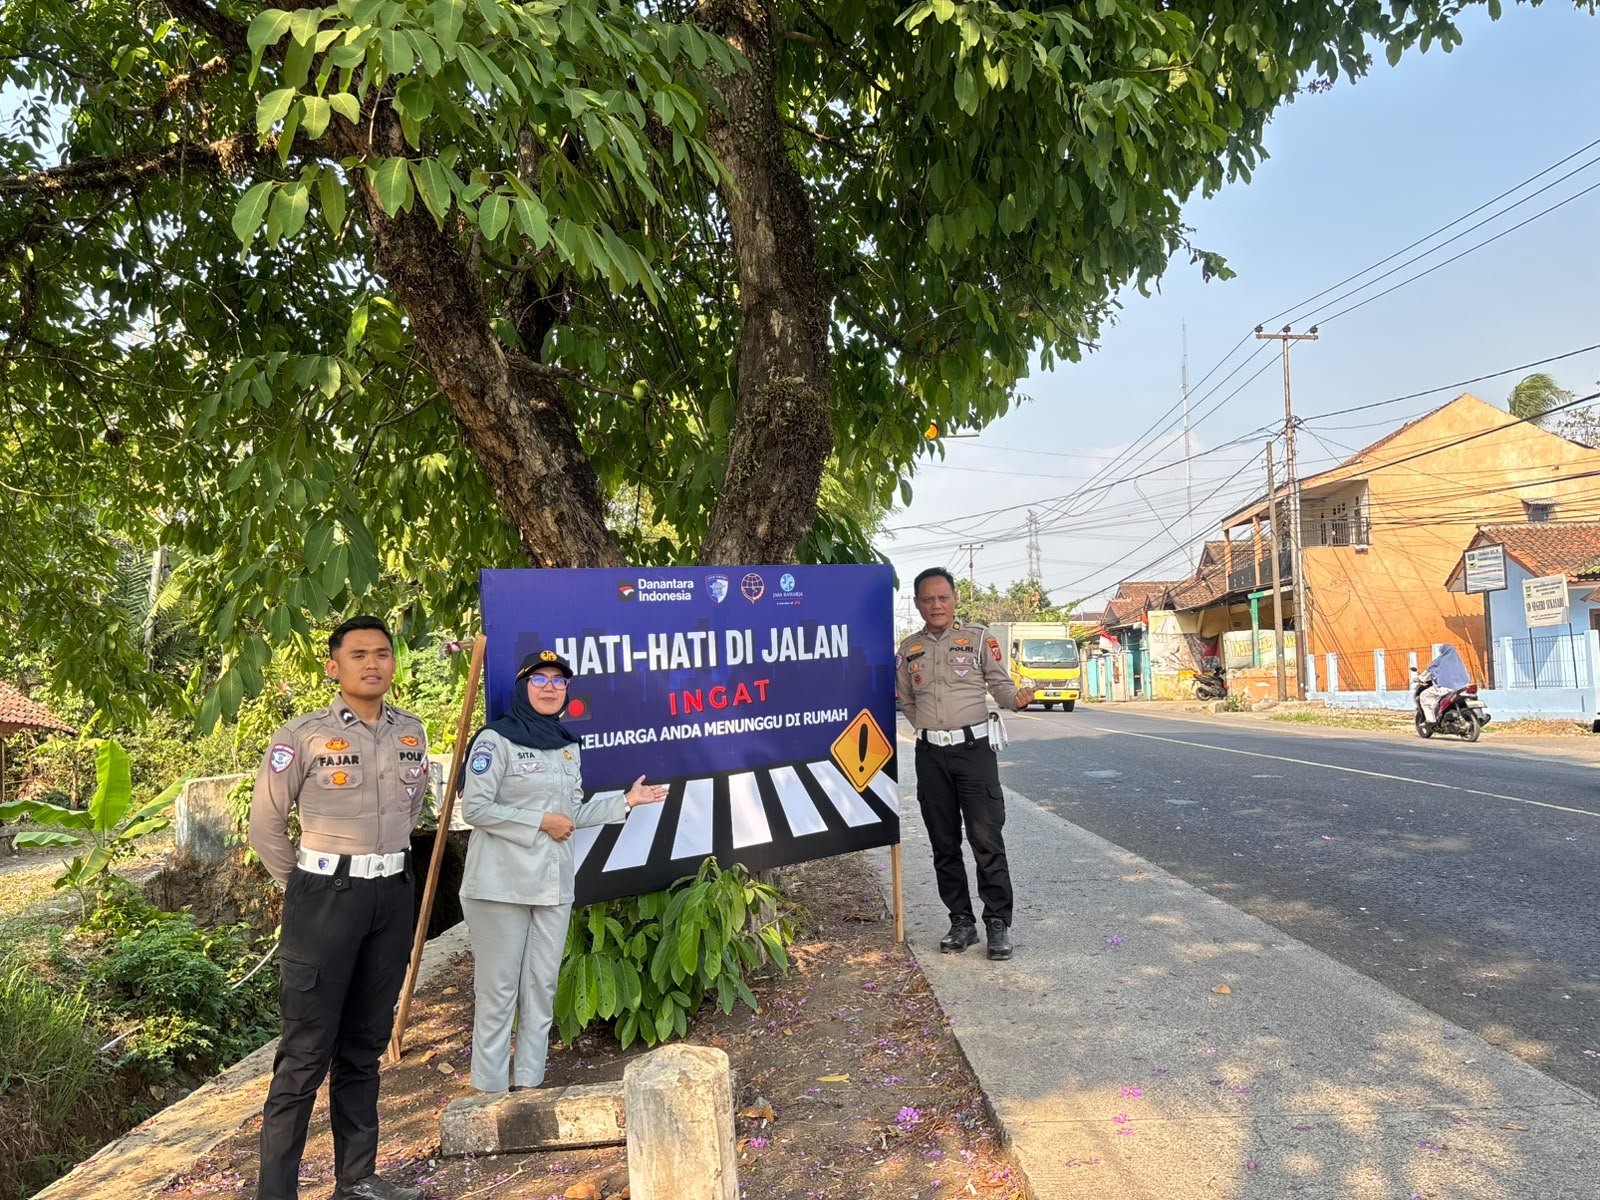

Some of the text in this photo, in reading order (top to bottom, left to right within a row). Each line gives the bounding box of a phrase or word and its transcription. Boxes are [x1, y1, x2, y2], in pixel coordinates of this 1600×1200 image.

[638, 578, 694, 590] Danantara
[639, 590, 692, 602] Indonesia
[555, 624, 849, 676] HATI-HATI DI JALAN
[669, 679, 770, 716] INGAT
[660, 722, 702, 741] ANDA
[704, 715, 783, 736] MENUNGGU
[785, 713, 801, 727] DI
[803, 708, 848, 725] RUMAH
[319, 755, 360, 767] FAJAR
